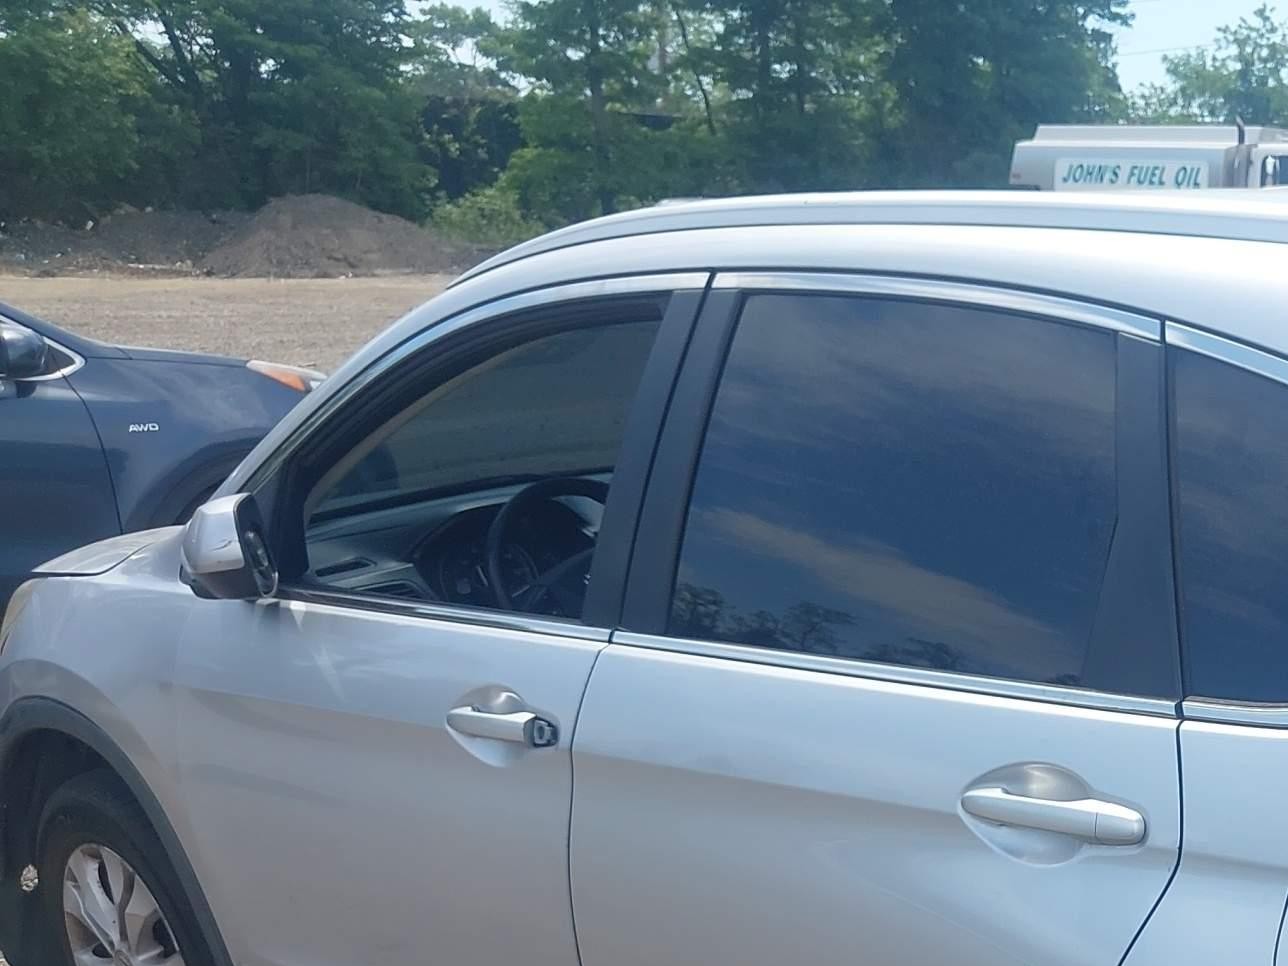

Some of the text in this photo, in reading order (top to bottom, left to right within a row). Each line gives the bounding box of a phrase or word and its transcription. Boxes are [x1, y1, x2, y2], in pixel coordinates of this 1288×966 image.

[1062, 164, 1201, 189] JOHN'S FUEL OIL
[128, 422, 160, 433] AWD
